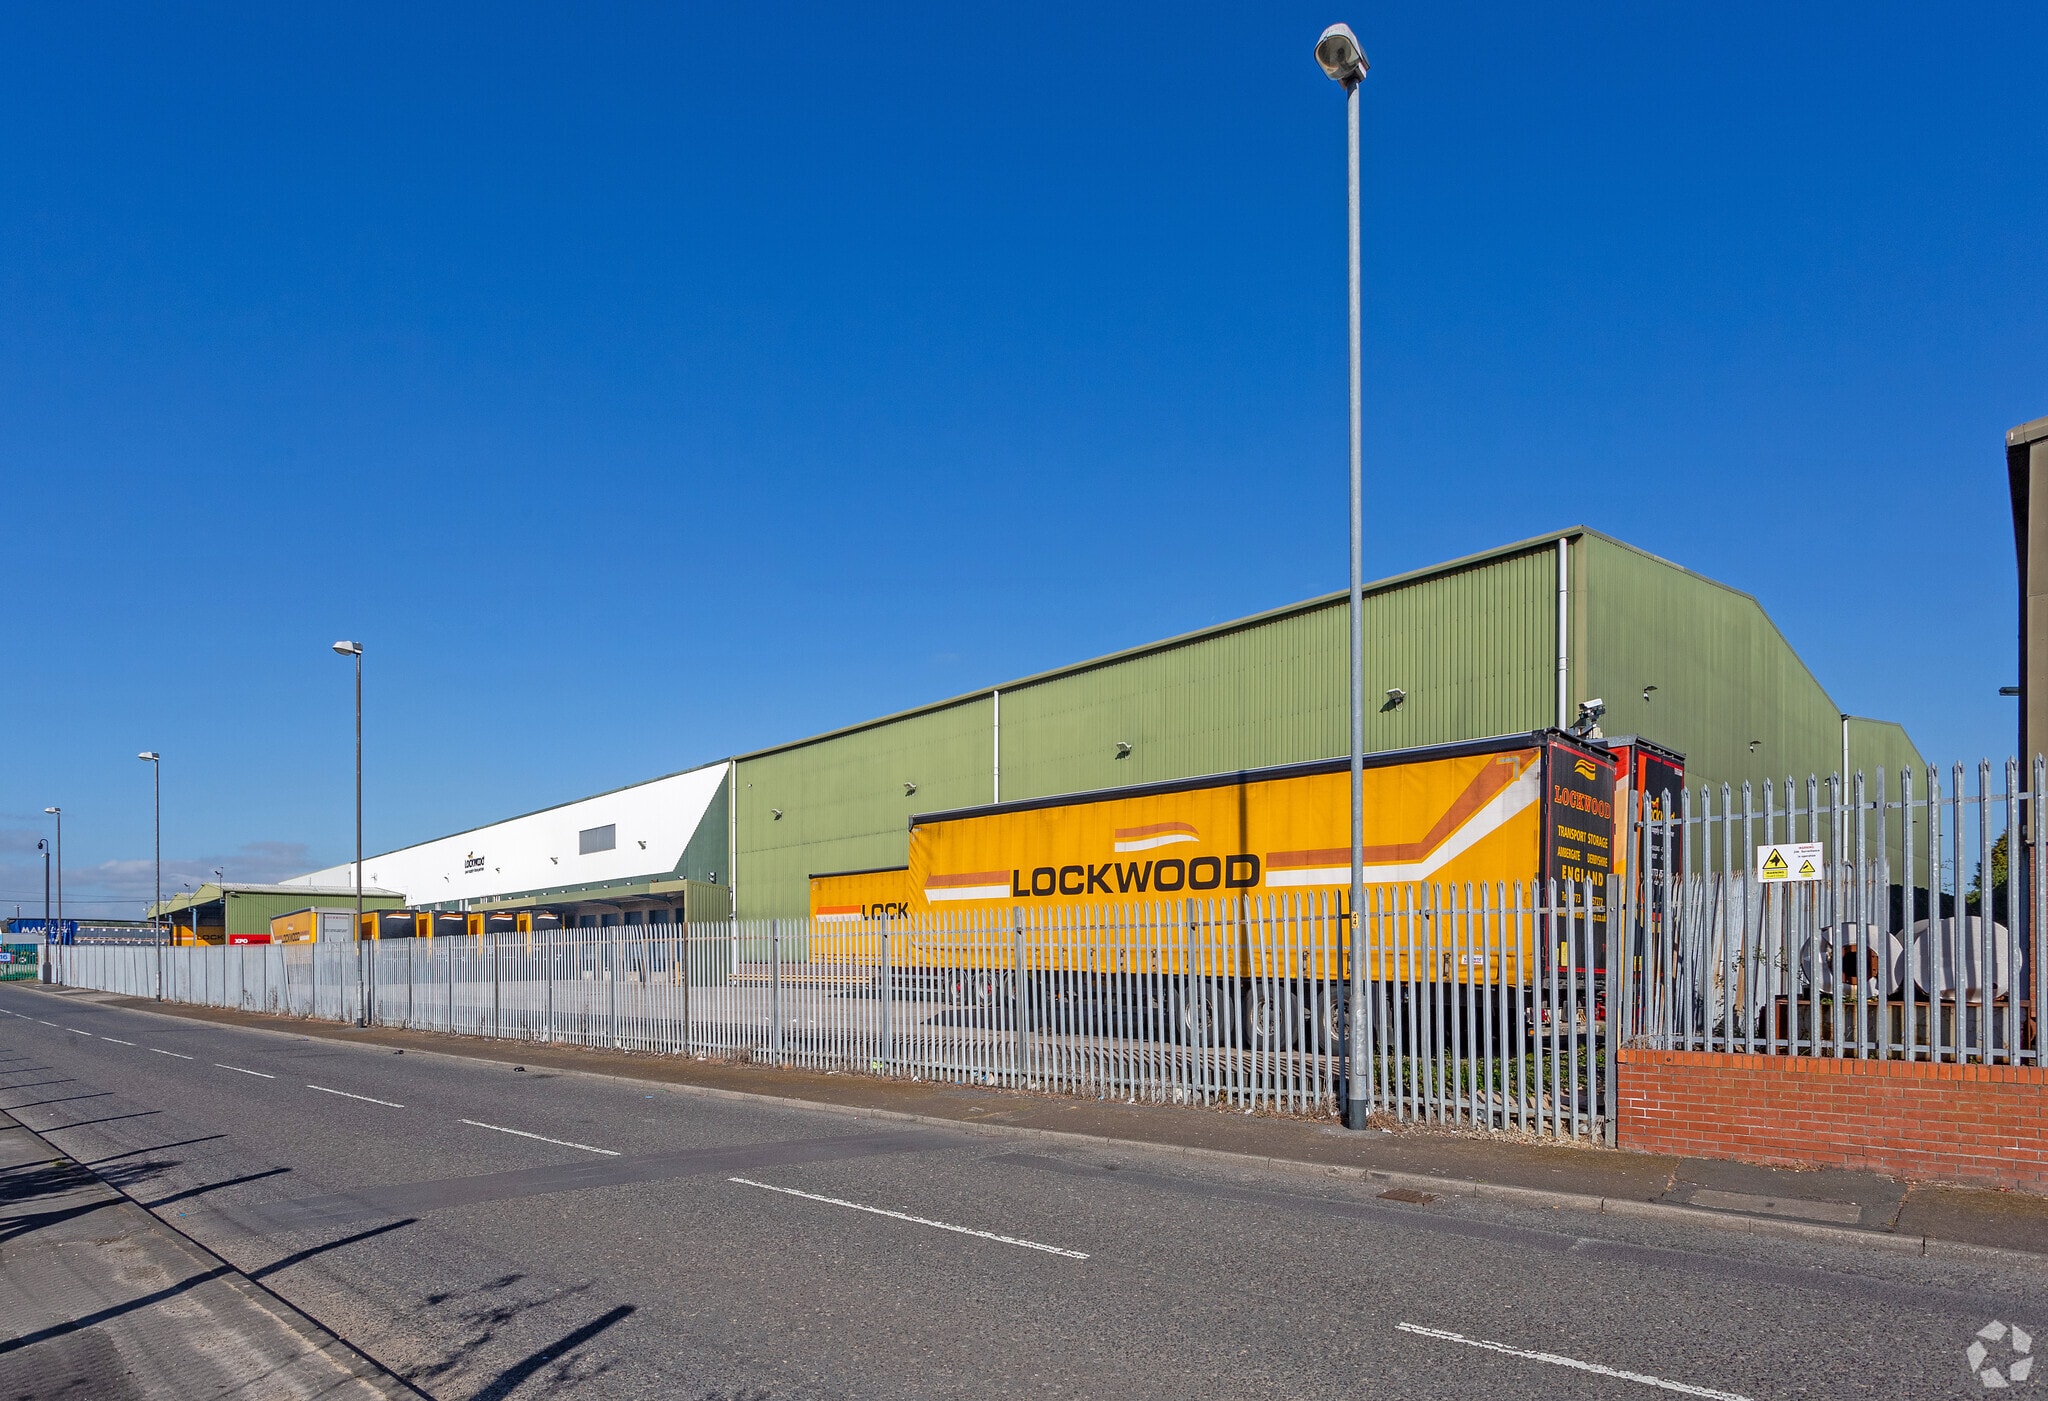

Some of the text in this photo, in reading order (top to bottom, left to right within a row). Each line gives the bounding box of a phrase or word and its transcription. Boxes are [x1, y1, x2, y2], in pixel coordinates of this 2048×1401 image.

[1554, 784, 1610, 819] LOCKWOOD
[1558, 825, 1608, 849] TRANSPORT STORAGE
[1012, 853, 1261, 898] LOCKWOOD
[862, 902, 908, 921] LOCK
